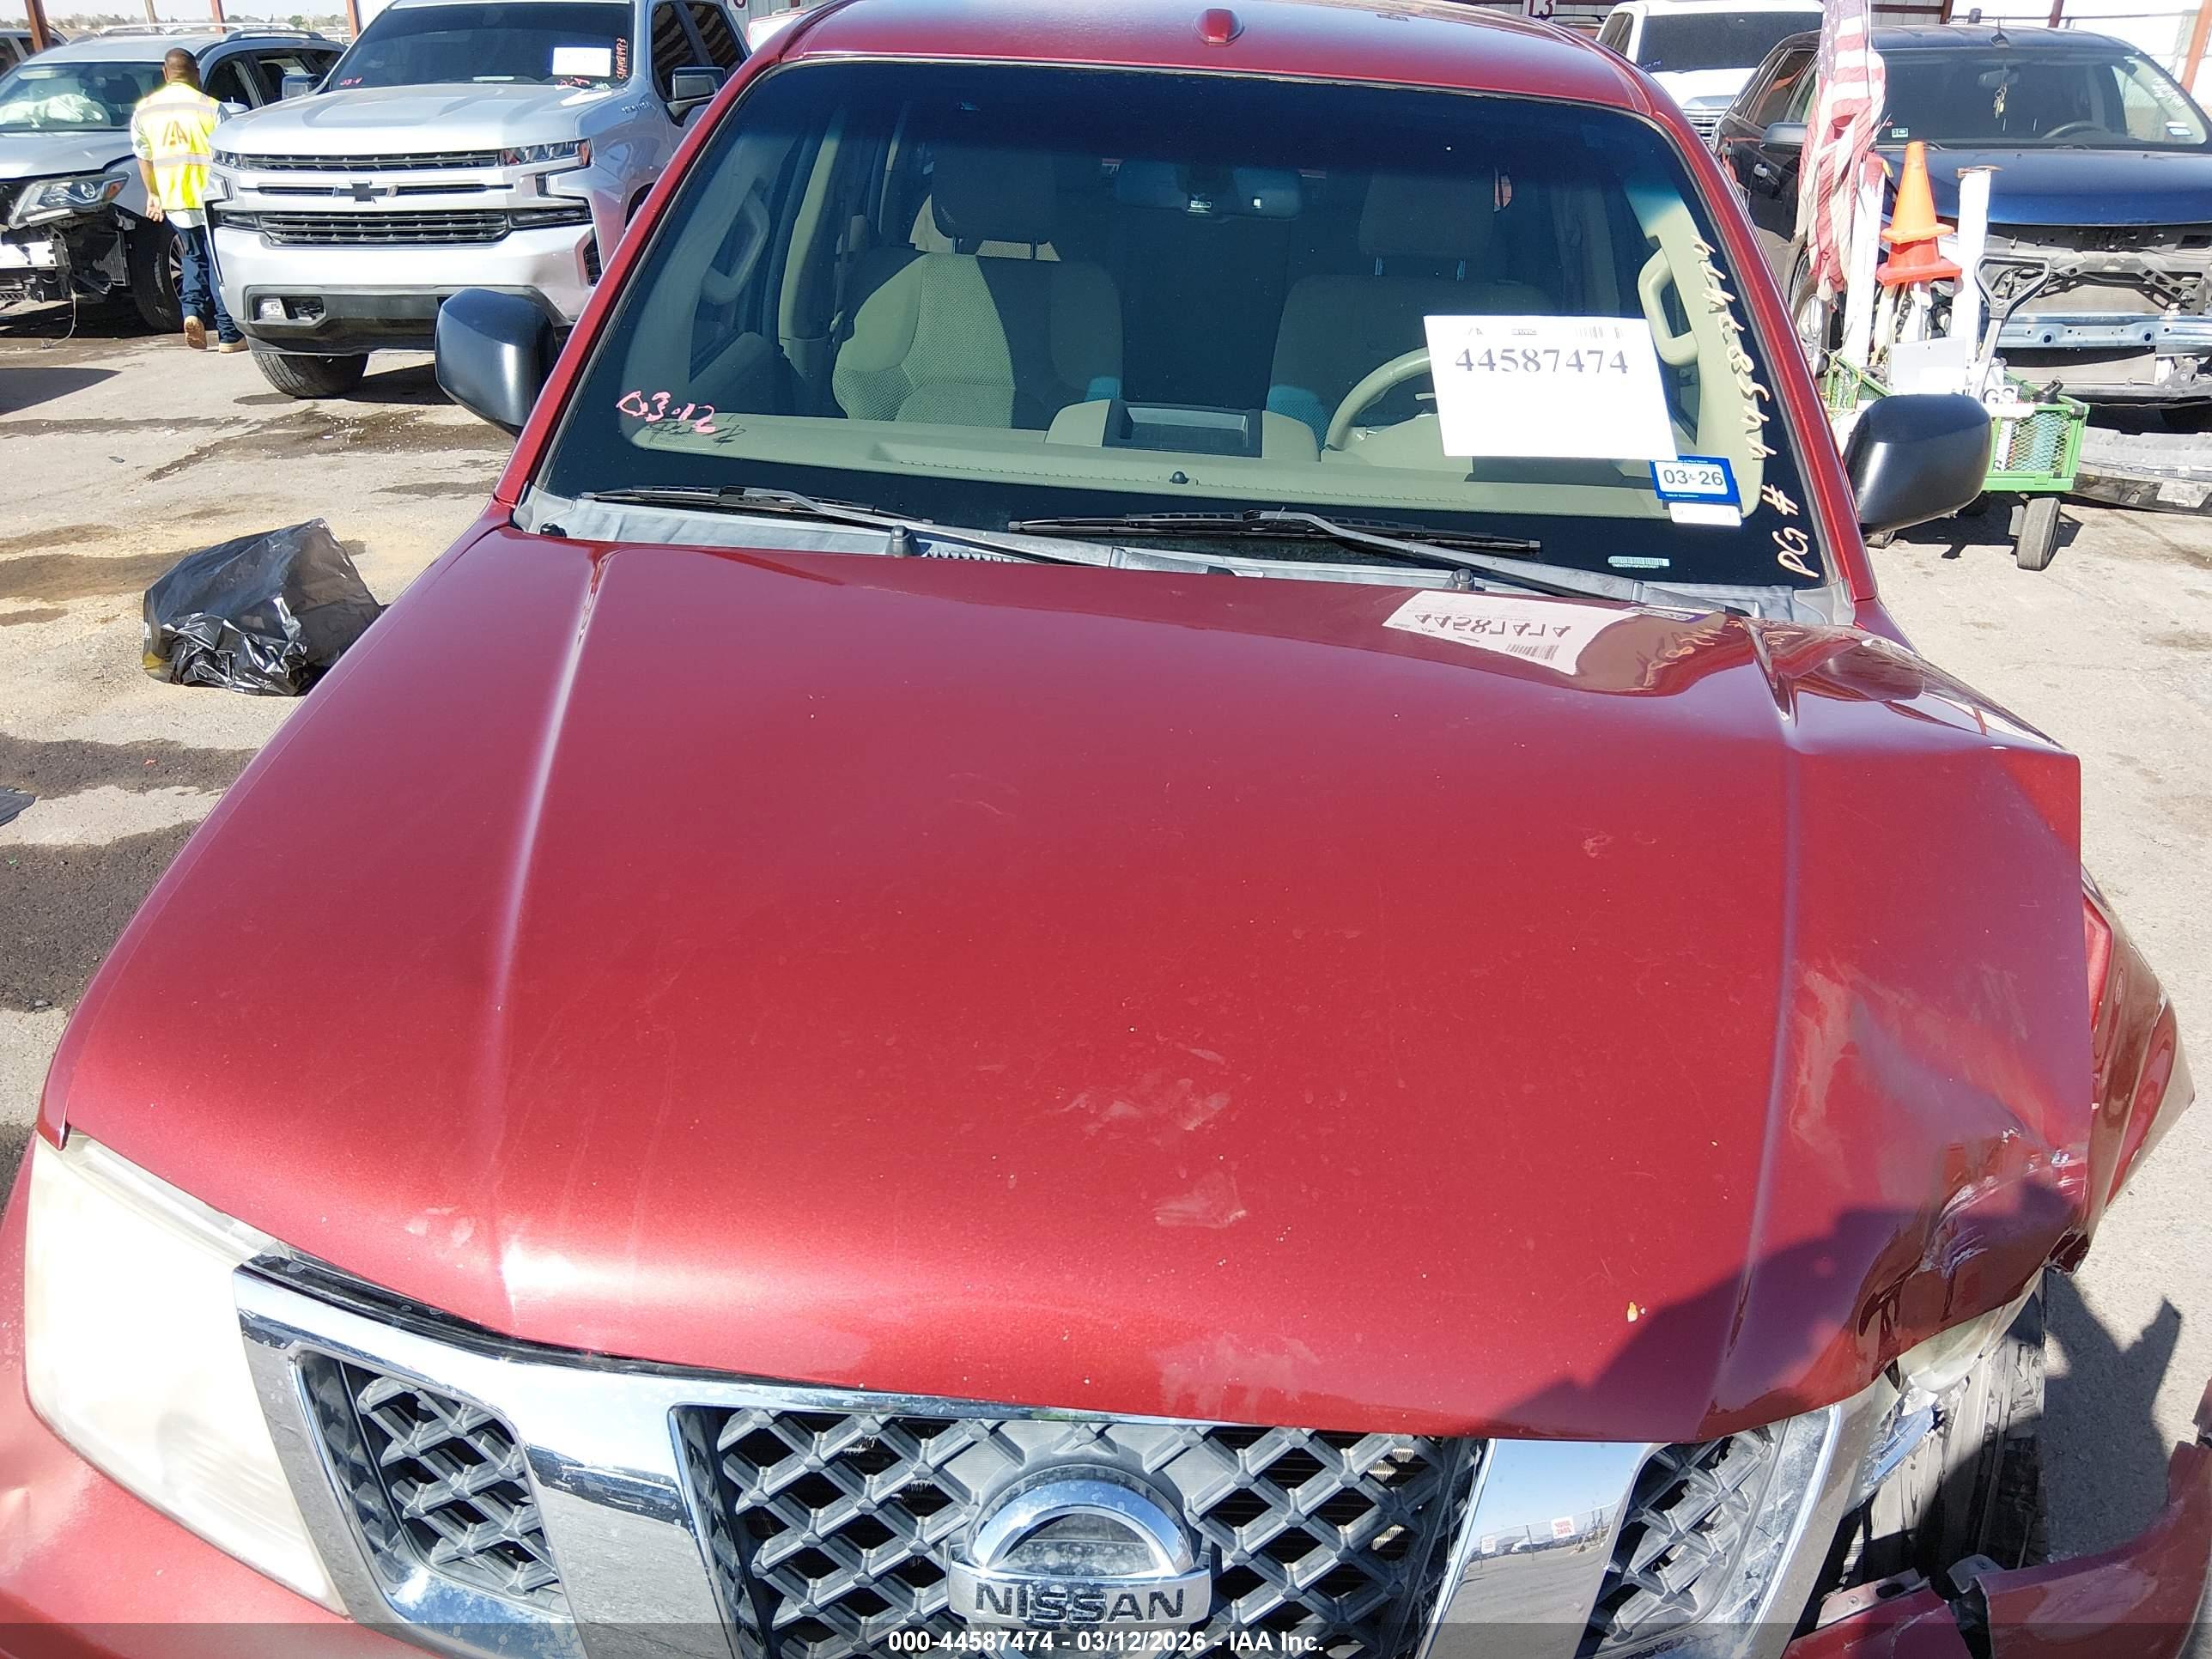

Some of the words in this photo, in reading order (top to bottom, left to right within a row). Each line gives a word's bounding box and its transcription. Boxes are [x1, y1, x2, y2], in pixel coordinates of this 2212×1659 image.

[1455, 348, 1629, 374] 44587474
[1662, 469, 1689, 484] 03
[1698, 471, 1724, 487] 26
[975, 1582, 1184, 1622] NISSAN
